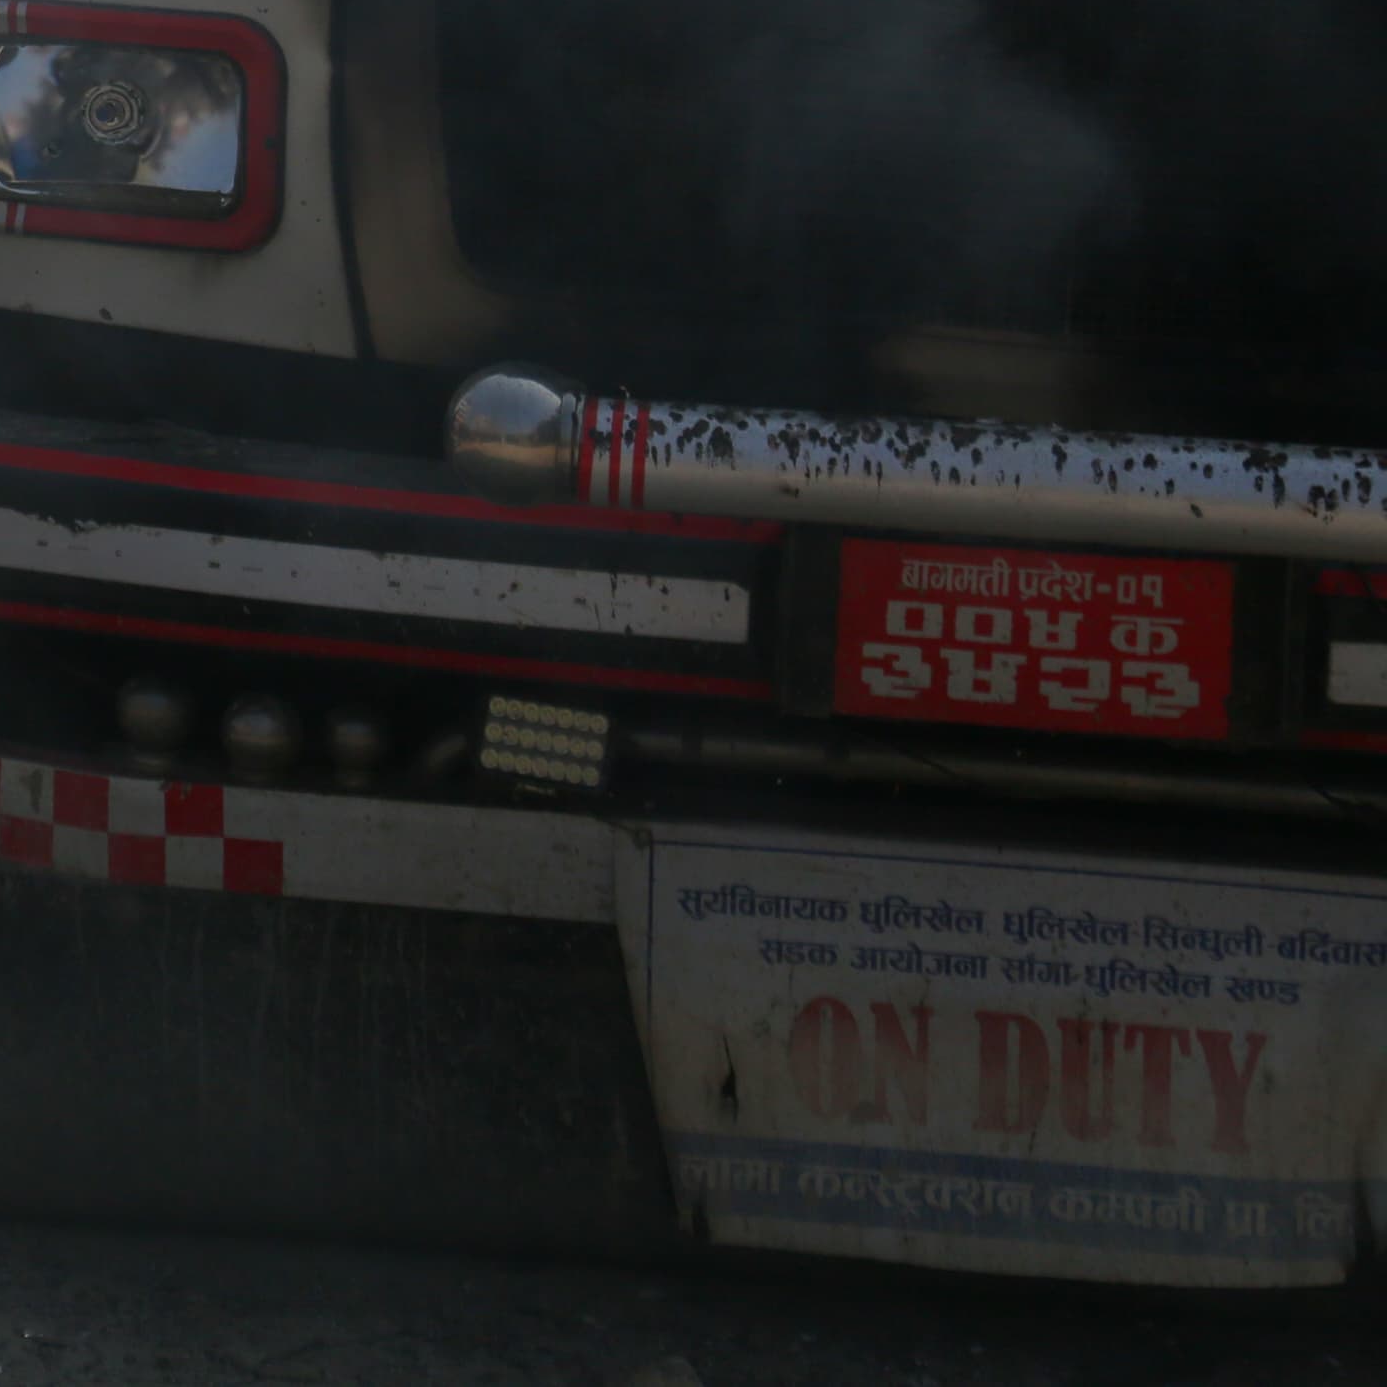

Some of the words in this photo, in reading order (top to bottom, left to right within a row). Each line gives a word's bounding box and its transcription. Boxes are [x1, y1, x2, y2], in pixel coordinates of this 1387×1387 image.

[901, 557, 1012, 597] बागमती
[1109, 614, 1184, 656] क
[760, 937, 838, 967] सडक
[851, 943, 988, 979] आयोजना
[1224, 975, 1301, 1005] खण्ड
[788, 994, 934, 1127] ON
[973, 1008, 1267, 1155] DUTY
[679, 1155, 781, 1195] लामा
[1045, 1182, 1210, 1234] कम्पनी
